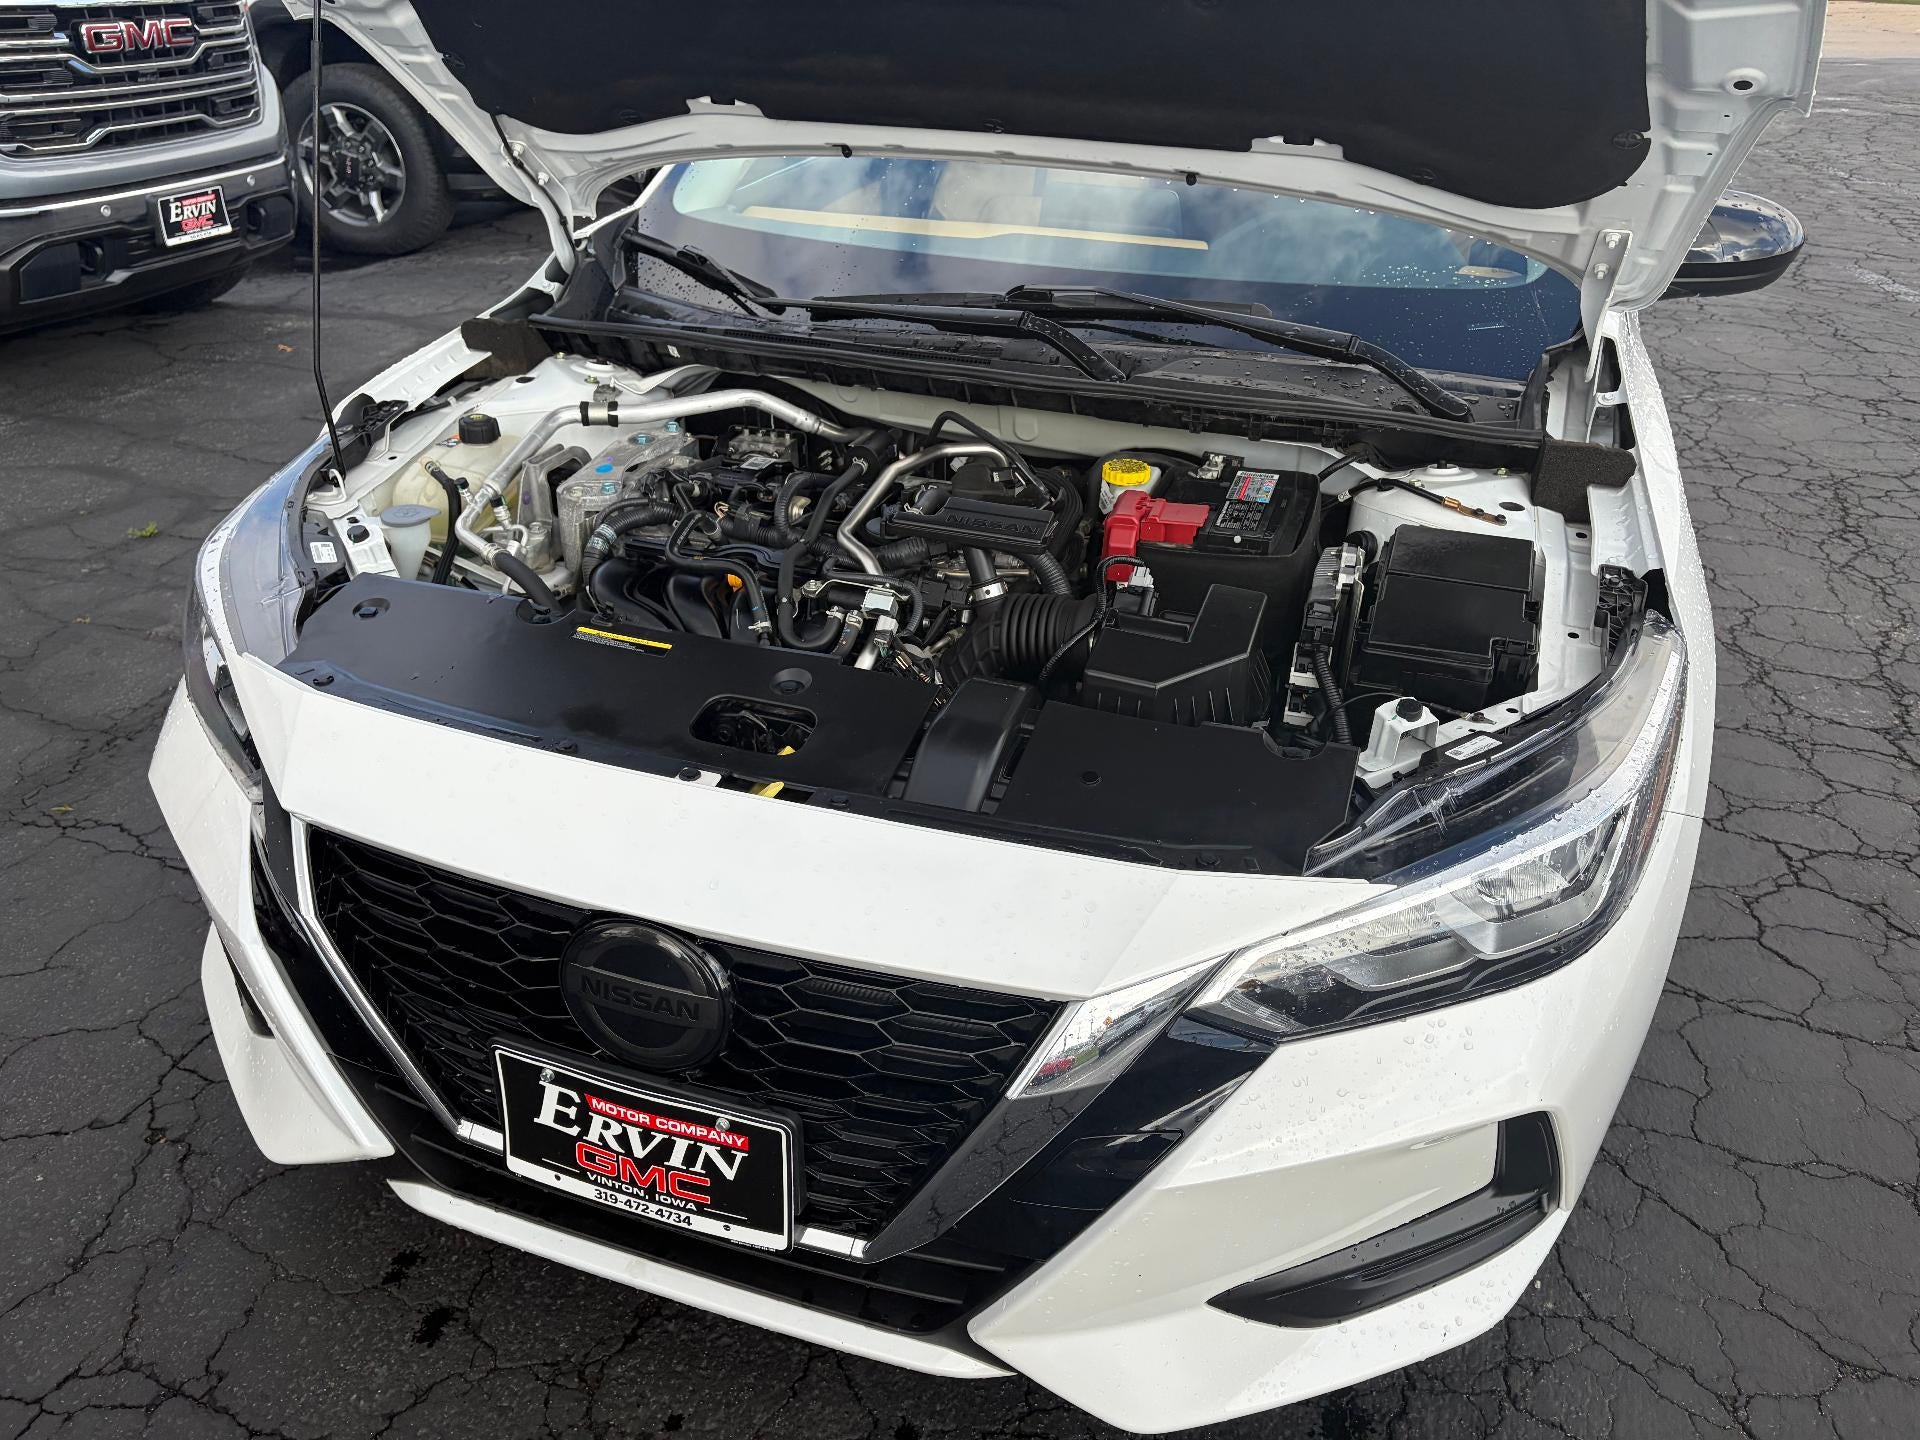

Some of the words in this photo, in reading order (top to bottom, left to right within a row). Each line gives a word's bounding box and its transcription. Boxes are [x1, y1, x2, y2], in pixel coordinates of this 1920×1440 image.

[80, 18, 194, 53] GMC
[169, 199, 216, 223] ERVIN
[181, 214, 214, 231] GMC
[581, 975, 700, 1022] NISSAN
[533, 1080, 748, 1181] ERVIN
[591, 1098, 650, 1125] MOTOR
[655, 1117, 745, 1147] COMPANY
[576, 1142, 711, 1204] GMC
[587, 1171, 649, 1199] VINTON,
[655, 1193, 697, 1211] IOWA
[594, 1188, 693, 1226] 319-472-4734
